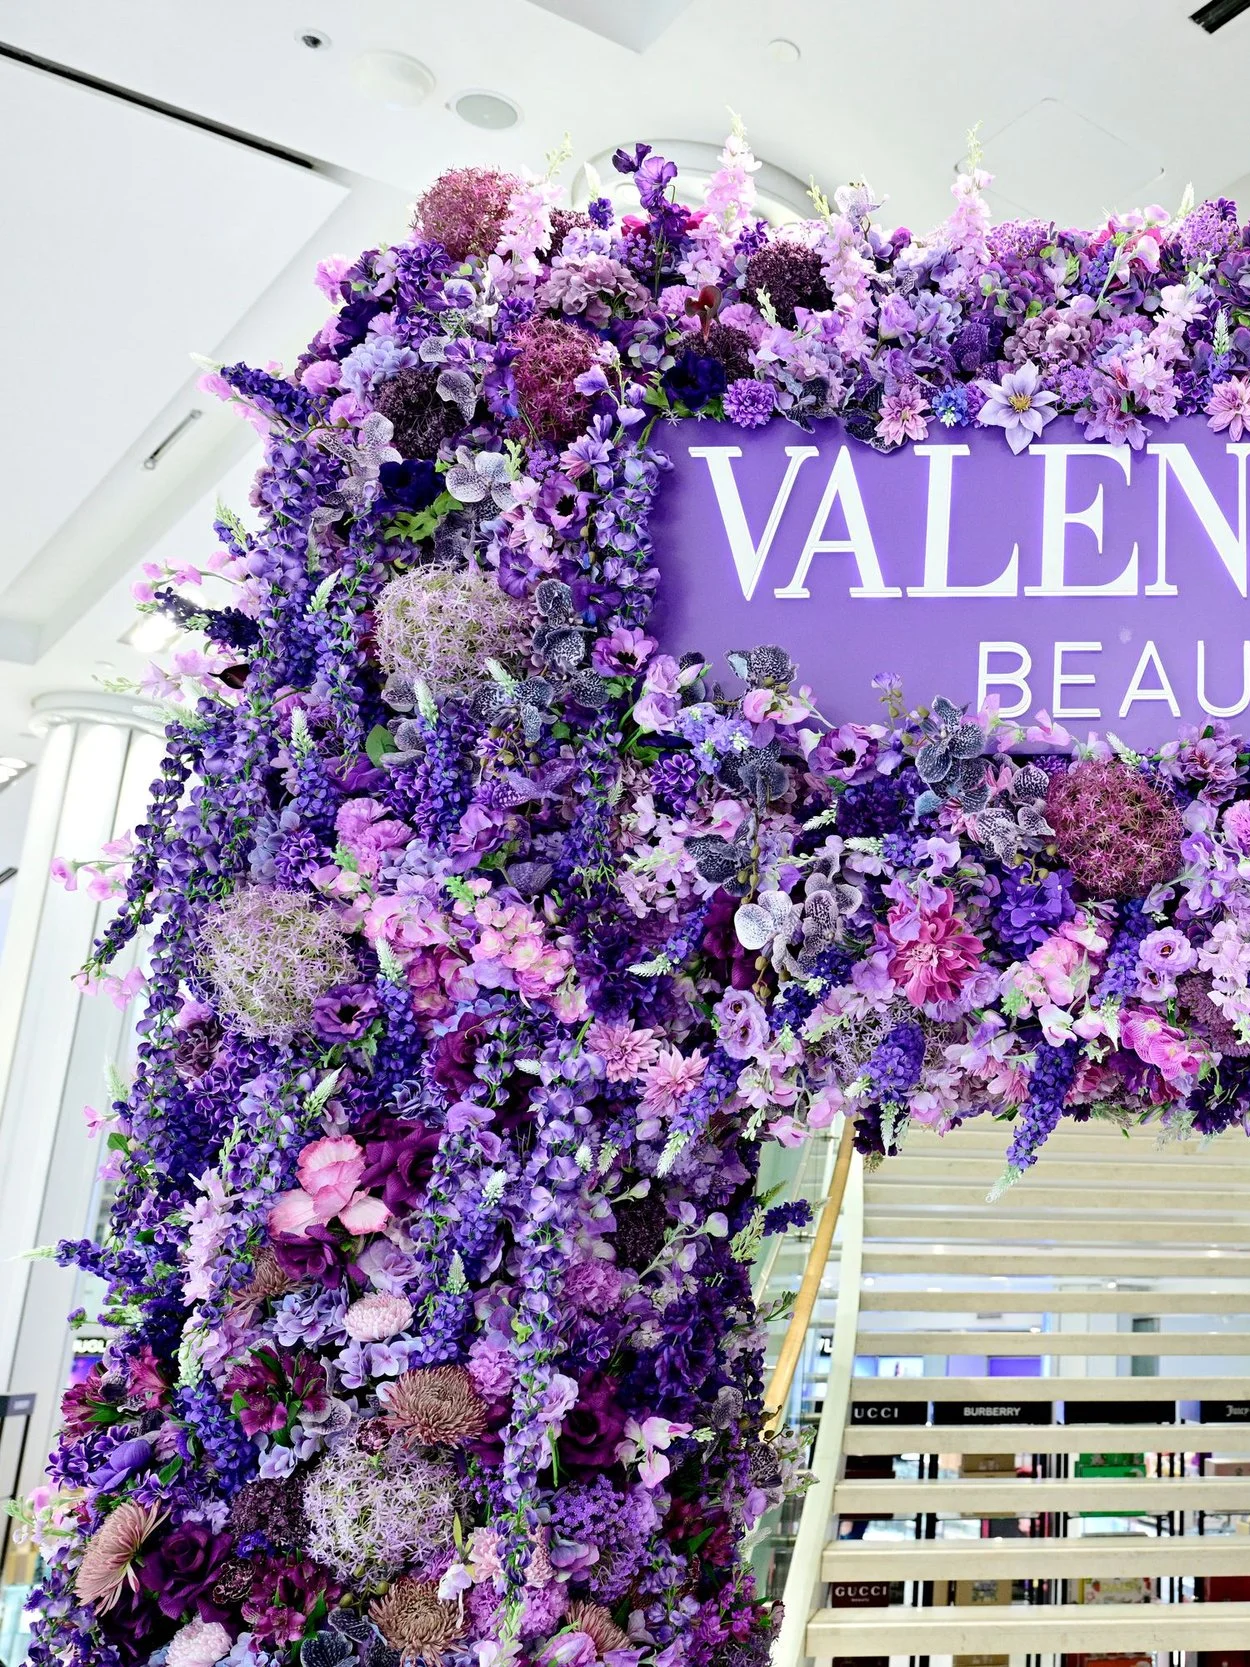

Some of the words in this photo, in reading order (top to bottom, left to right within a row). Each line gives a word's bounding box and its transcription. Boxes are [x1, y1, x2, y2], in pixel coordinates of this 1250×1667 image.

[853, 1406, 899, 1419] UCCI
[963, 1406, 1021, 1417] BURBERRY
[1225, 1404, 1249, 1417] Juicy
[834, 1585, 888, 1597] GUCCI
